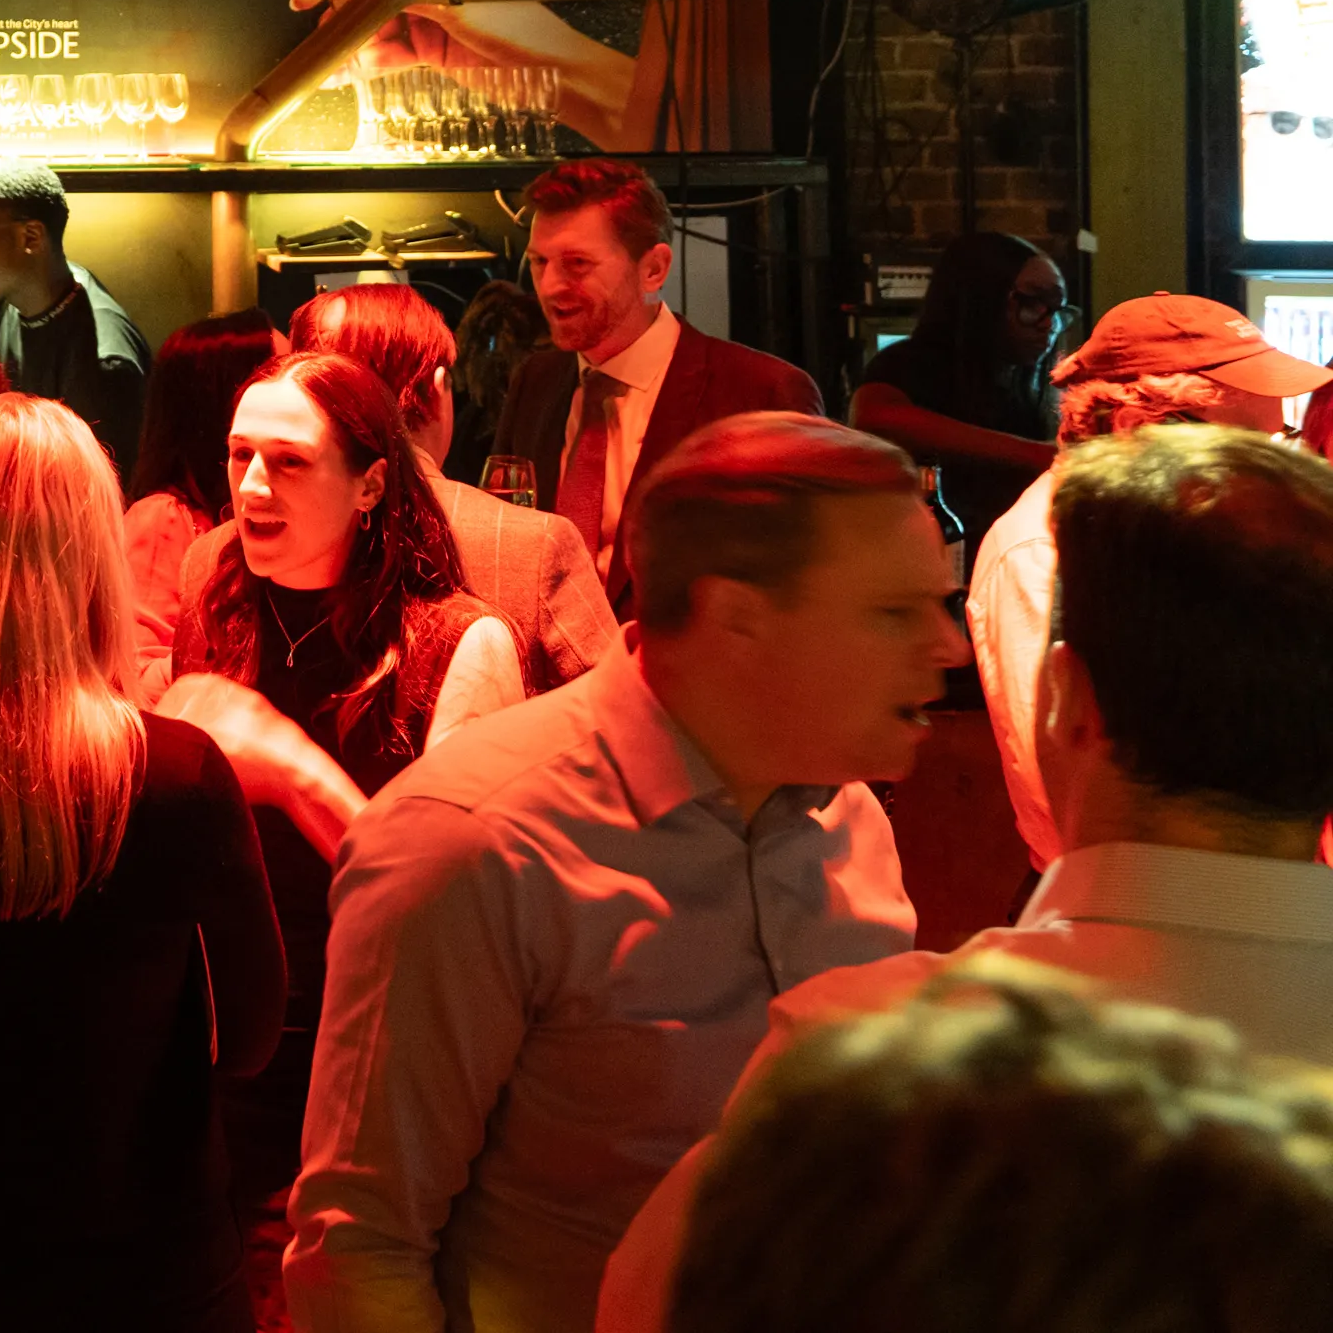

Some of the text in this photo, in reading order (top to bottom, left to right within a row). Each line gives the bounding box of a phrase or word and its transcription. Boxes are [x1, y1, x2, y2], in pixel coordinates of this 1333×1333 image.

[5, 19, 22, 29] the
[22, 19, 51, 31] City's
[51, 19, 80, 29] heart
